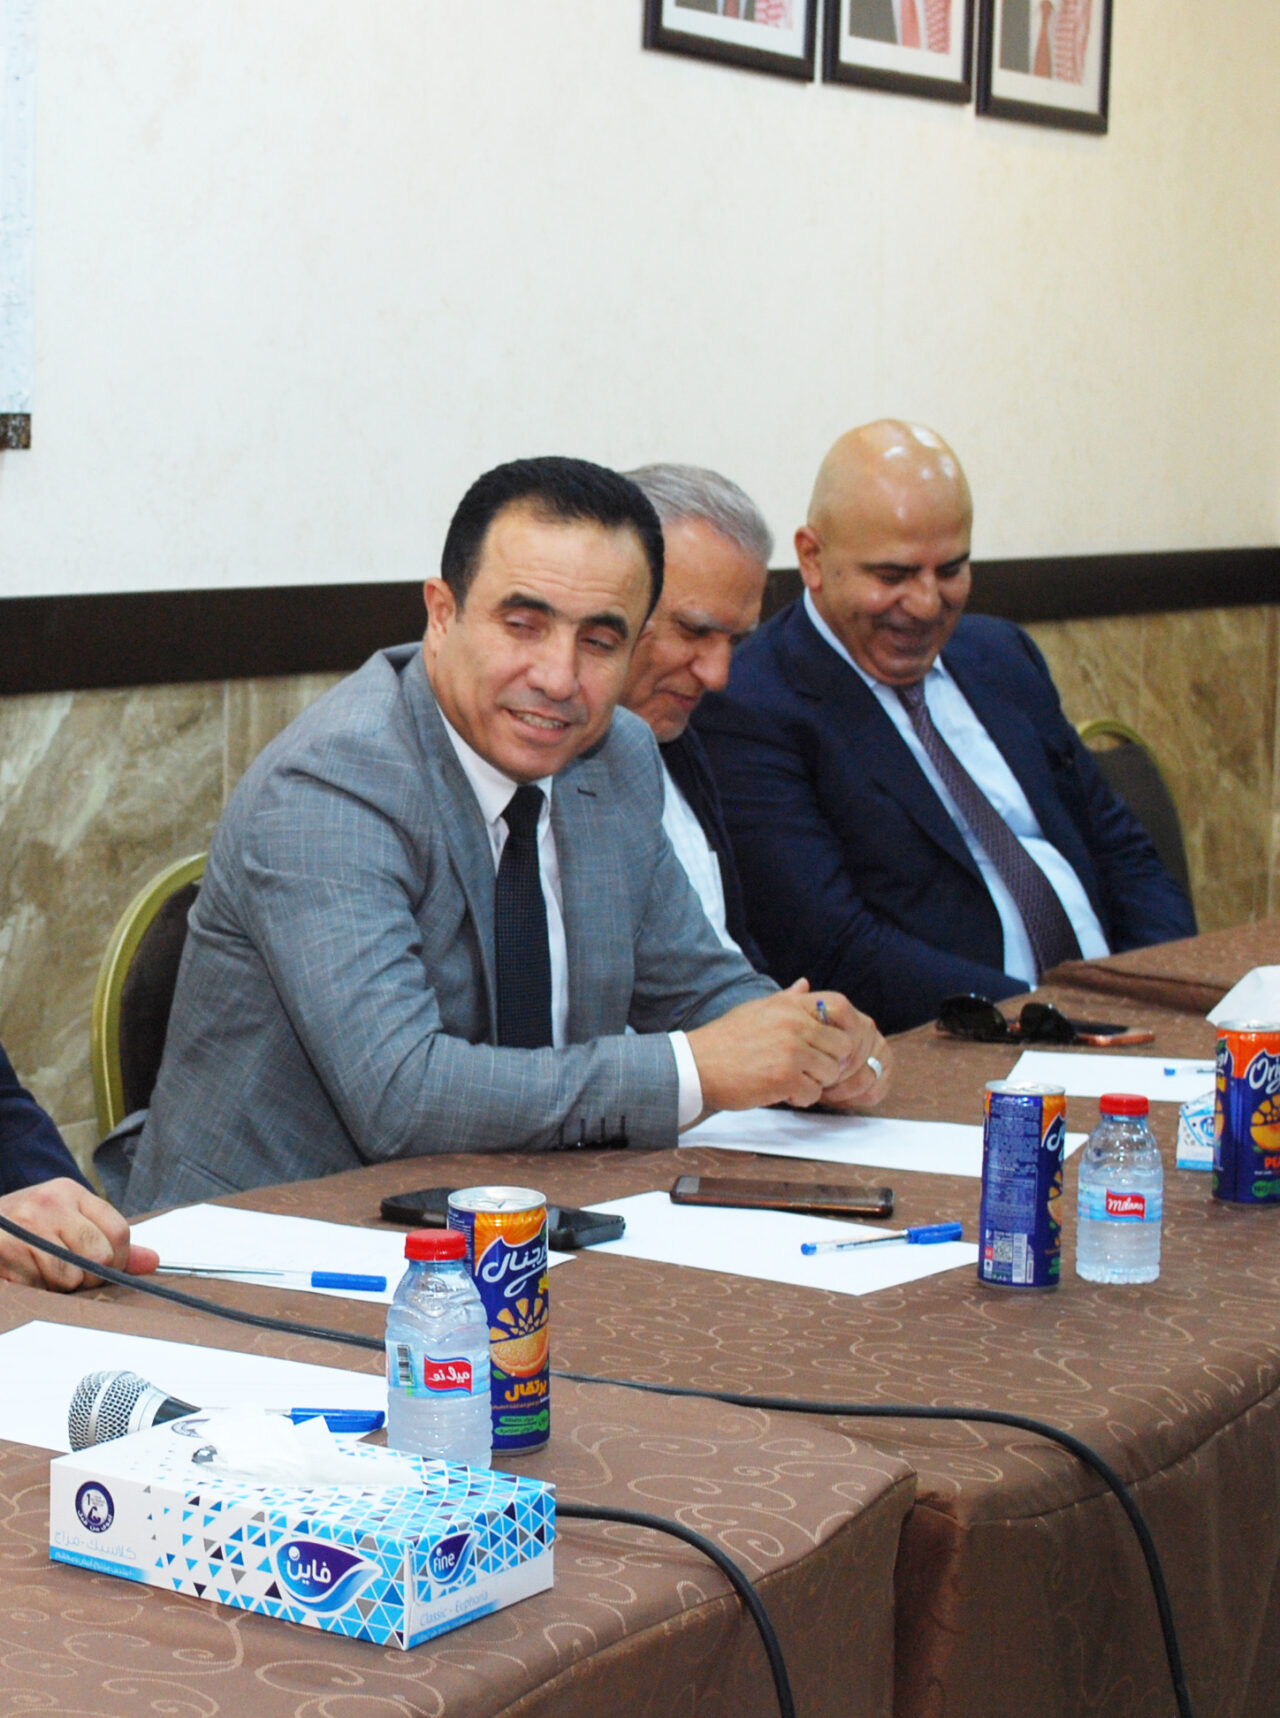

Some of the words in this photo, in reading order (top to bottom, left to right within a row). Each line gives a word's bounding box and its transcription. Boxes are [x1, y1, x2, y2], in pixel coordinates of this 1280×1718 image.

[1108, 1197, 1144, 1212] Milano
[286, 1546, 332, 1585] فاين
[433, 1547, 456, 1574] fine
